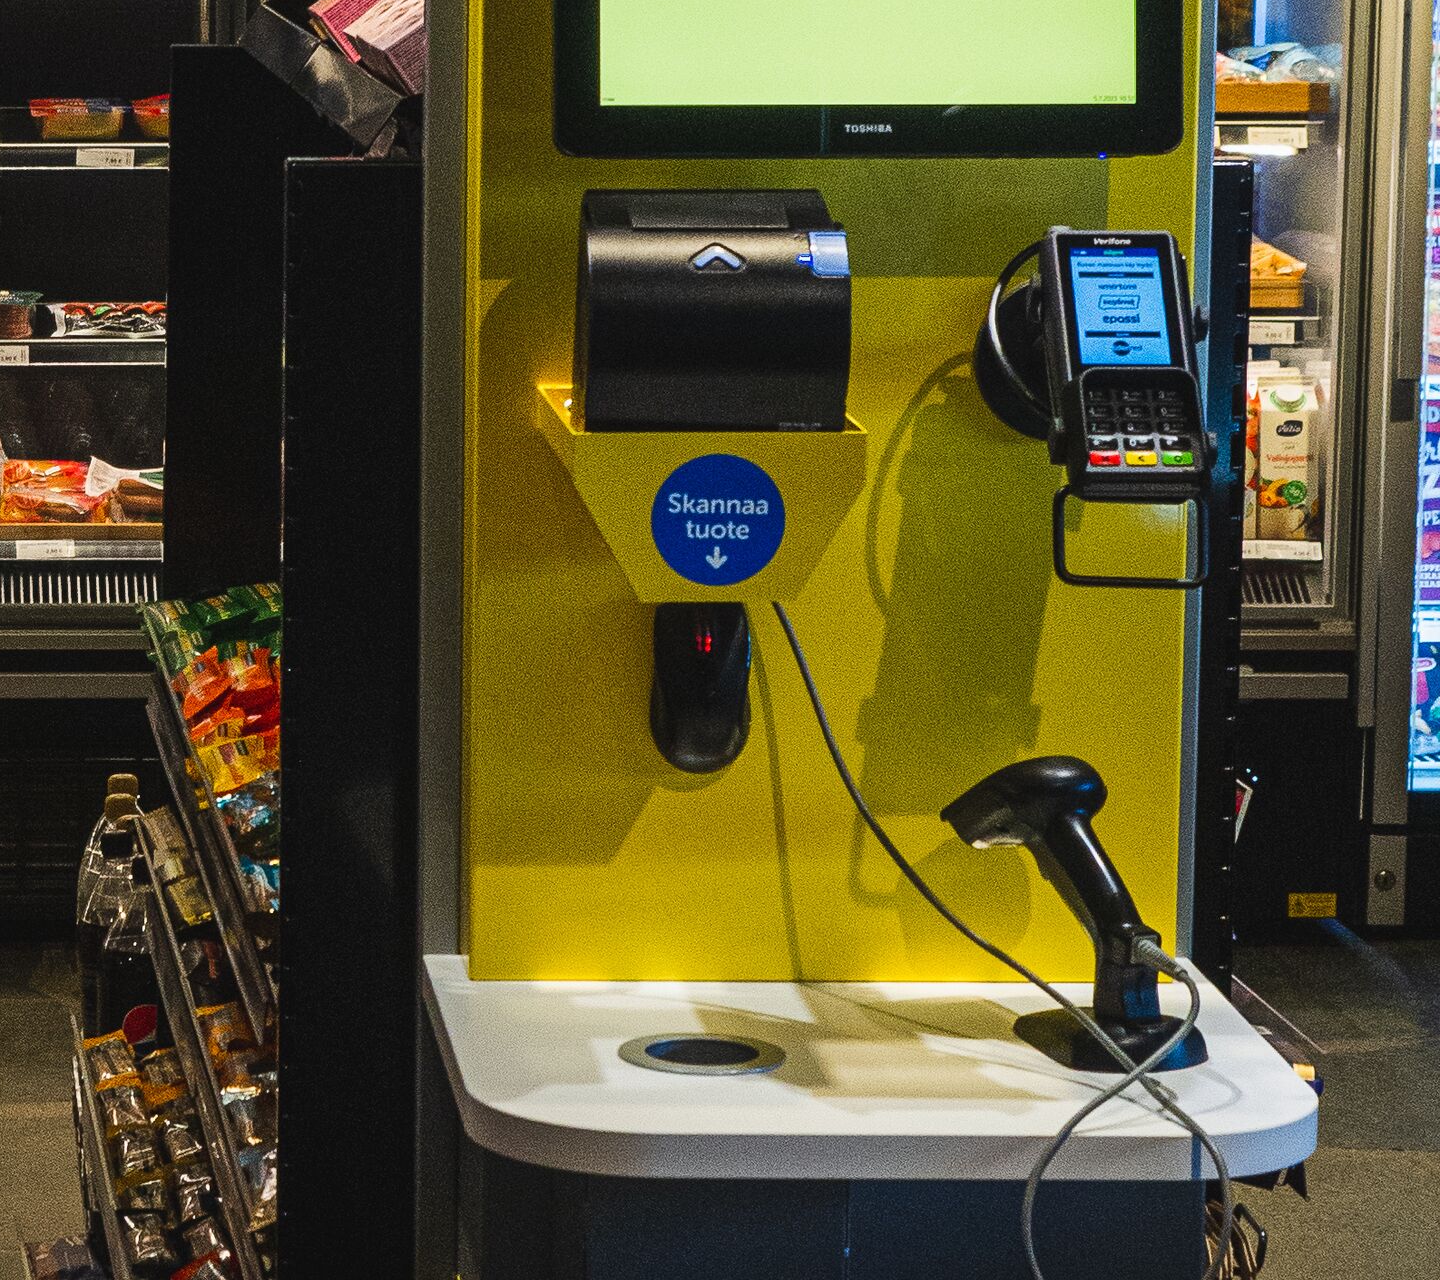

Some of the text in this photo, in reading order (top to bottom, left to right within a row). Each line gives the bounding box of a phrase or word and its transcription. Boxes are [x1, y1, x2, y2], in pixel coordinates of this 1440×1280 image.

[845, 124, 893, 134] TOSHIBA
[1093, 238, 1132, 246] Verifone
[1102, 313, 1140, 325] epassi
[668, 492, 769, 517] Skannaa
[685, 518, 750, 542] tuote
